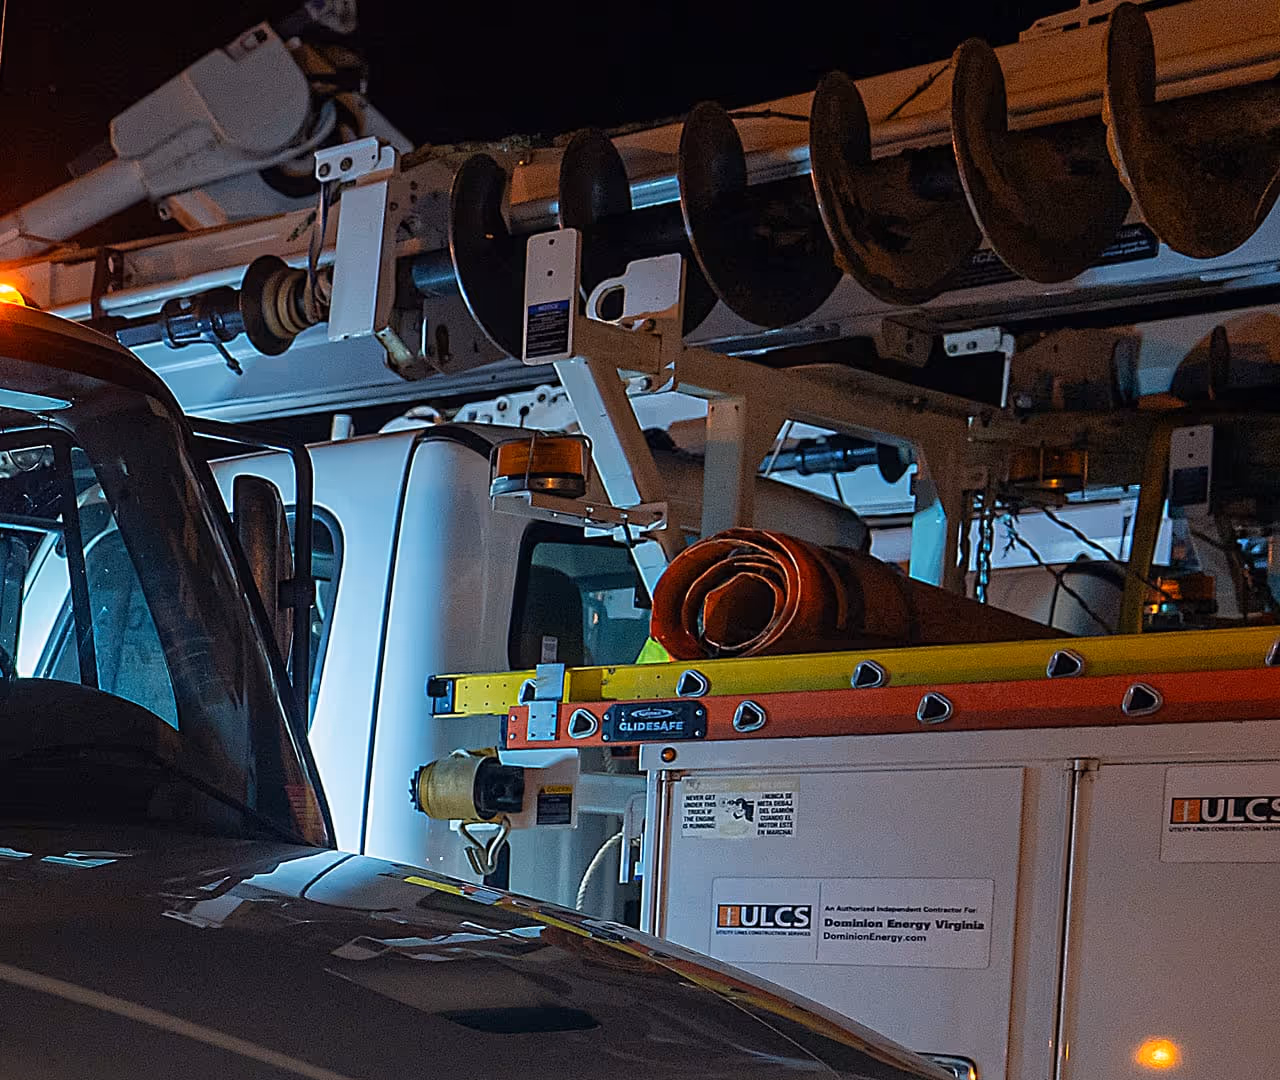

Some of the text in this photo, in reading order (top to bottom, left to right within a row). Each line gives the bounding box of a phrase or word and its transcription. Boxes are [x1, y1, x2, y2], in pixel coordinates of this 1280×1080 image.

[619, 720, 685, 732] GLIDESAFE
[741, 906, 809, 928] ULCS
[824, 918, 984, 931] Dominion Energy Virginia
[823, 932, 927, 942] DominionEnergy.com
